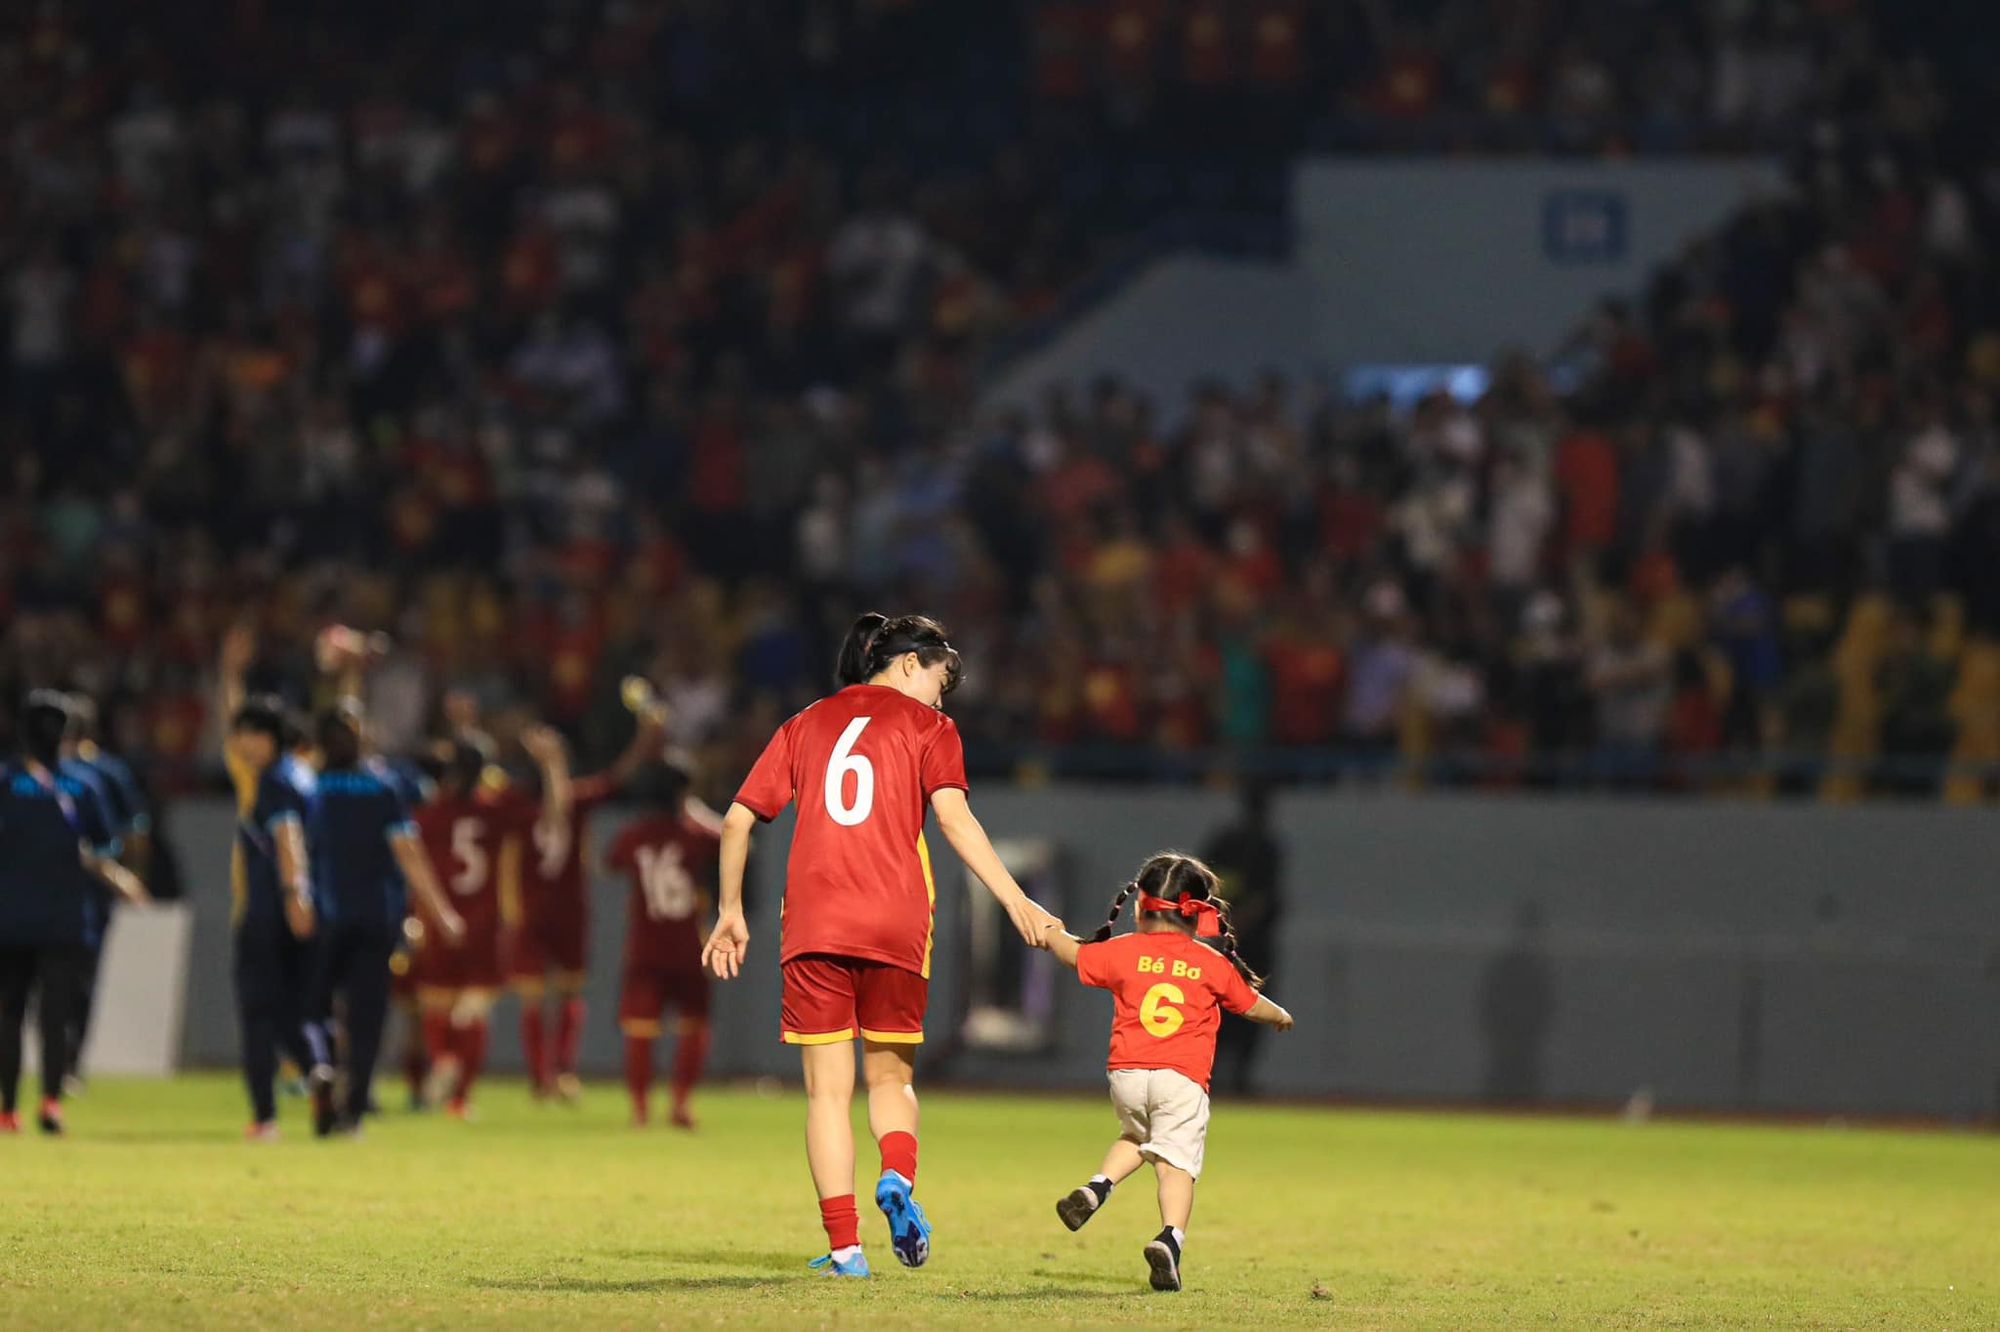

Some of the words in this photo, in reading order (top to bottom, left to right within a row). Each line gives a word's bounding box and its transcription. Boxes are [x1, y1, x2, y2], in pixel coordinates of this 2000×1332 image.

[824, 716, 874, 826] 6
[451, 815, 489, 896] 5
[634, 841, 694, 920] 16
[1137, 955, 1165, 974] Bé
[1171, 959, 1202, 980] Bơ
[1139, 982, 1185, 1038] 6
